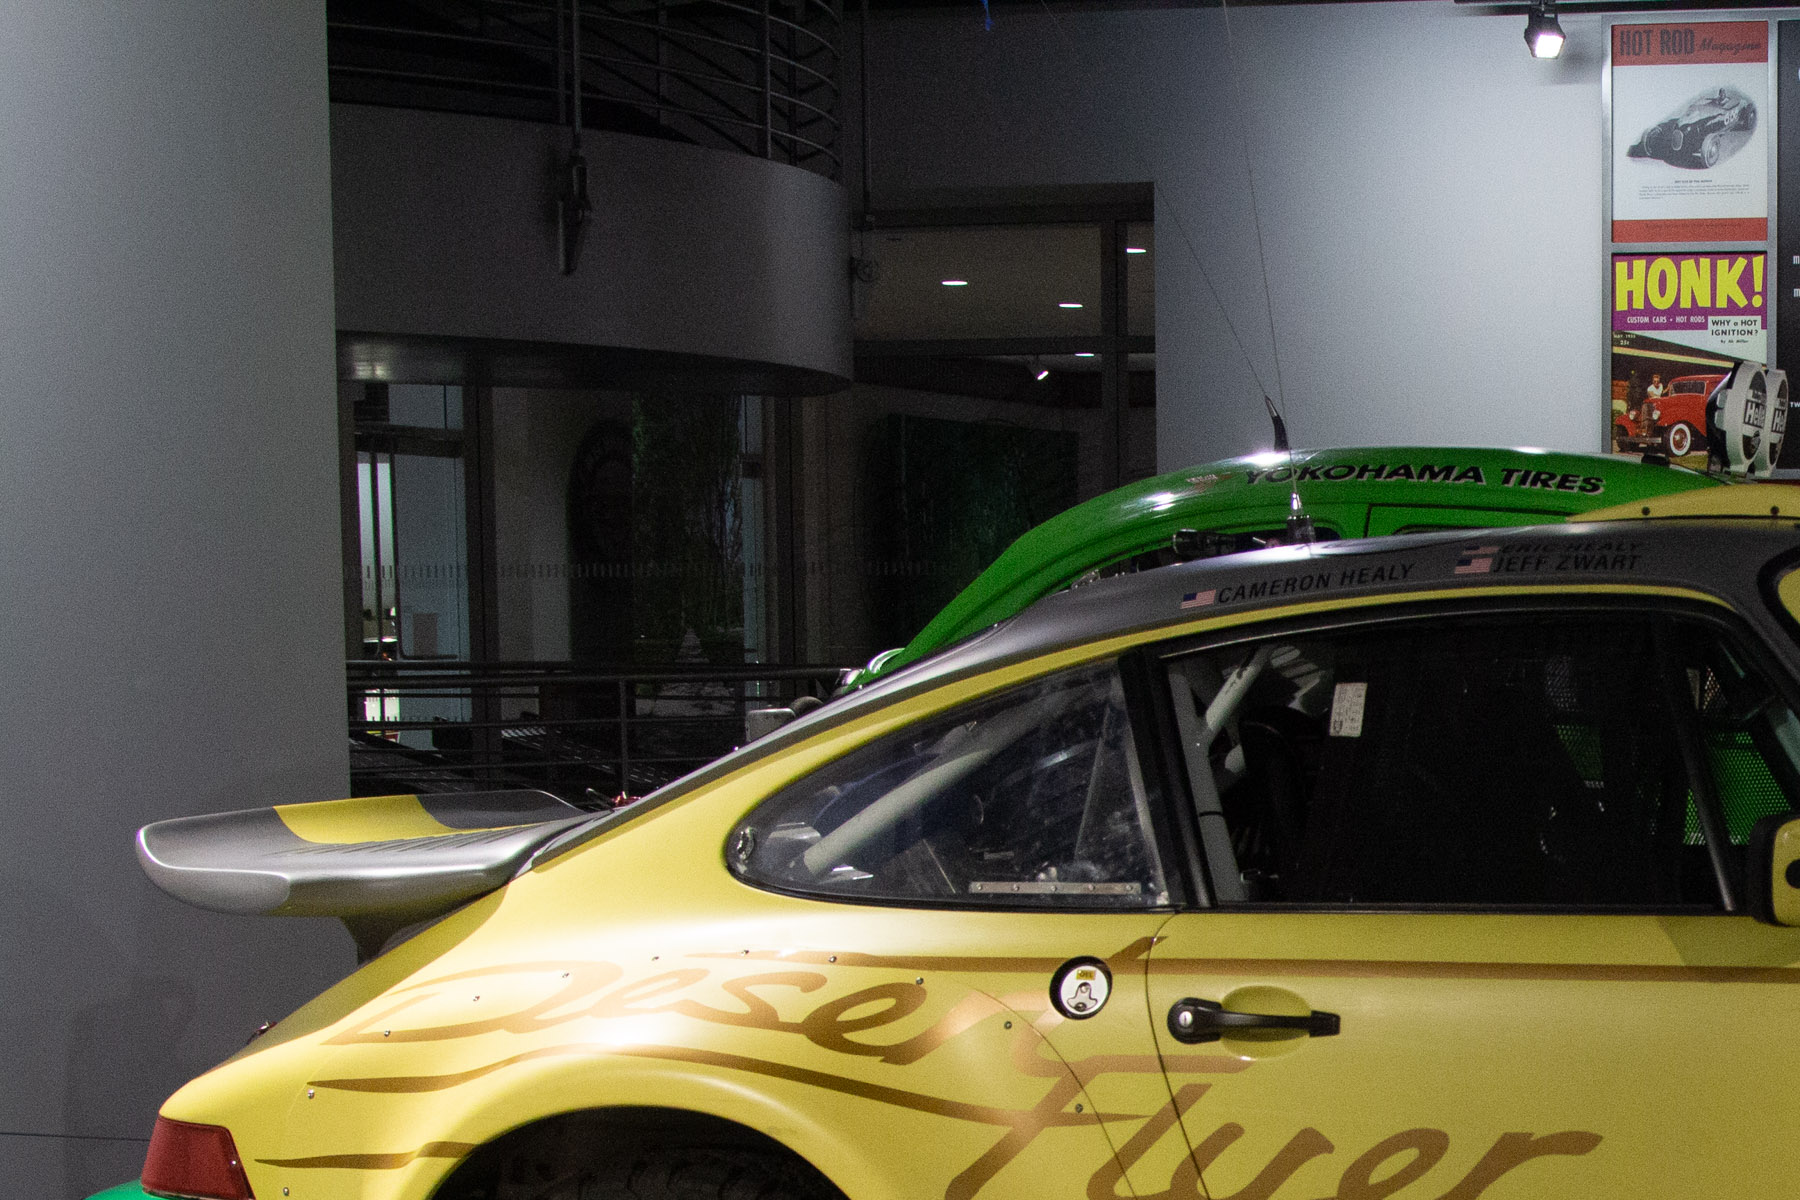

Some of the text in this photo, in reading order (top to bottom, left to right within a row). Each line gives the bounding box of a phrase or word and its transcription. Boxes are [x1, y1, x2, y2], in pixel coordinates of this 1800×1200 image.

[1619, 28, 1762, 56] HOT ROD Magazine
[1614, 255, 1765, 311] HONK!
[1626, 316, 1650, 324] CUSTOM
[1652, 316, 1667, 324] CARS
[1689, 315, 1705, 323] RODS
[1711, 319, 1758, 327] WHY HOT
[1711, 328, 1759, 336] IGNITION?
[1244, 463, 1487, 487] YOKOHAMA
[1500, 467, 1606, 495] TIRES
[1494, 555, 1642, 573] JEFF ZWART
[1217, 562, 1417, 605] CAMERON HEALY
